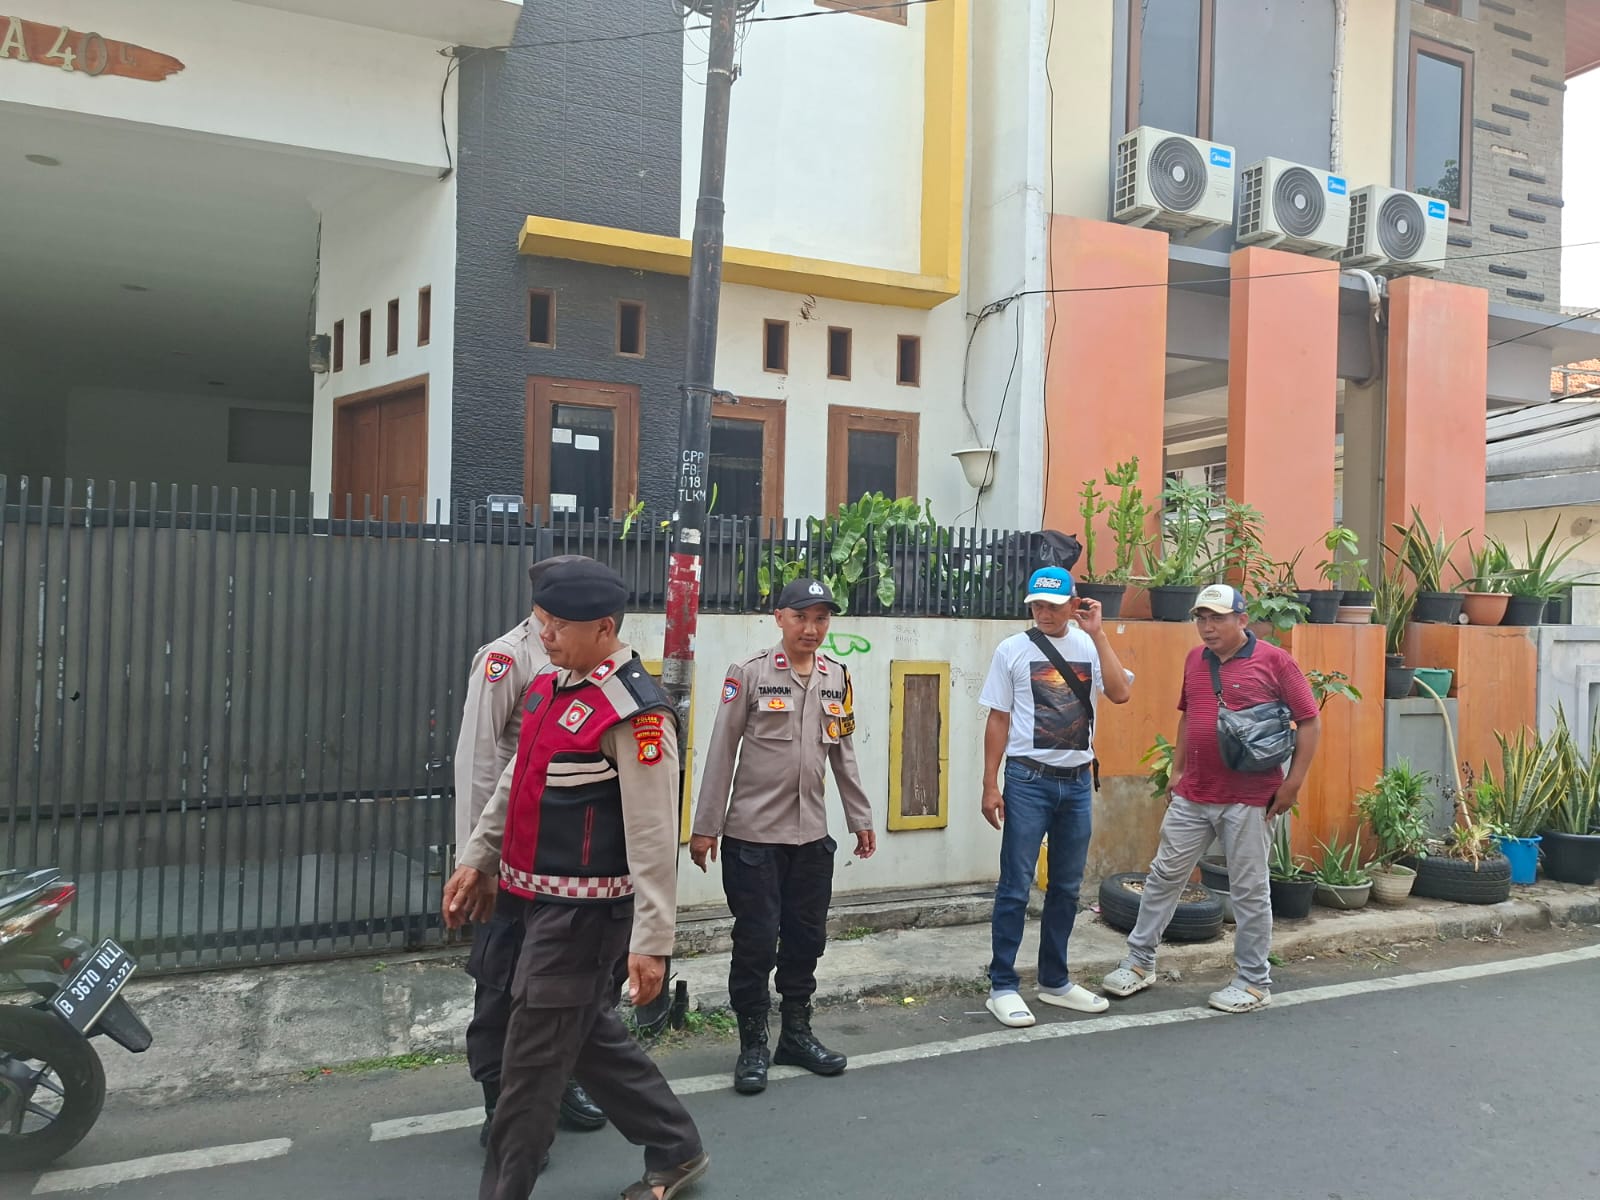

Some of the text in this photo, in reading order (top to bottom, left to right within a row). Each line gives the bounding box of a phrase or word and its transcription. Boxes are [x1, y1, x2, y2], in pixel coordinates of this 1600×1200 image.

[682, 450, 704, 463] CPP
[758, 686, 791, 695] TANGGUH
[59, 946, 121, 1015] B 3670 ULL
